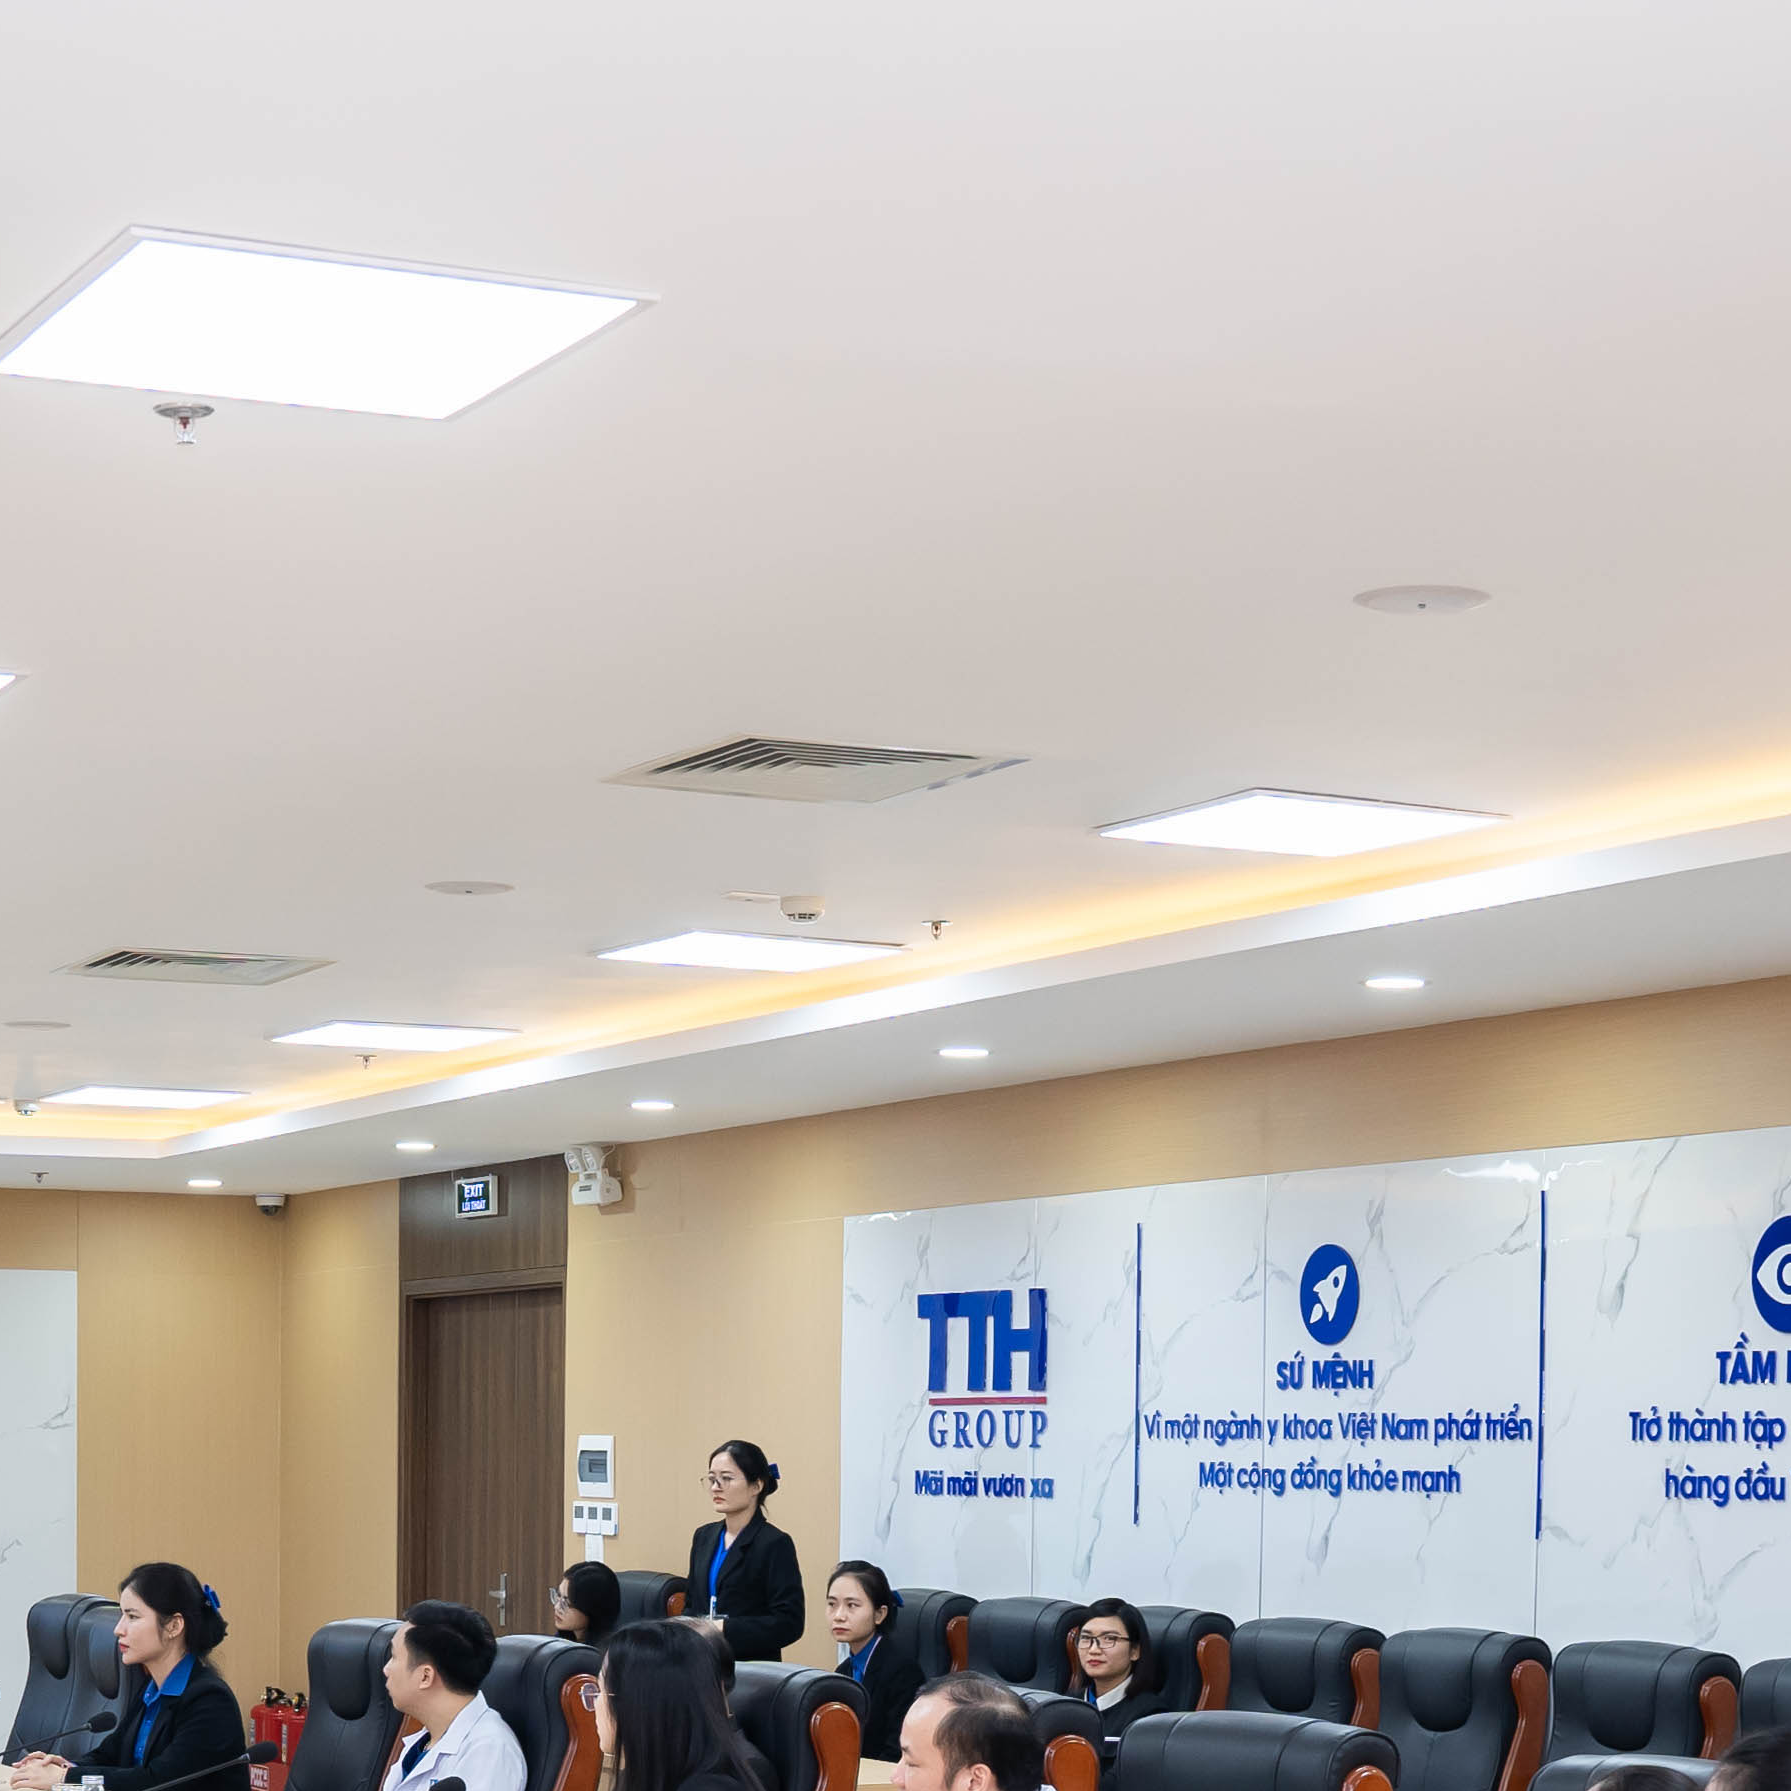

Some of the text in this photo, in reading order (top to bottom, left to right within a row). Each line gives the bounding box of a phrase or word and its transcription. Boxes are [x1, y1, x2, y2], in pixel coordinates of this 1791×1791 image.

[464, 1183, 484, 1198] EXIT
[917, 1288, 1048, 1392] TTH
[1716, 1333, 1777, 1384] TẦM
[1276, 1352, 1374, 1396] SỨ MỆNH
[929, 1409, 1047, 1448] GROUP
[1144, 1403, 1533, 1447] Vì một ngành y khoa Việt Nam phát triển
[1629, 1406, 1663, 1442] Trở
[1668, 1408, 1737, 1443] thành
[1743, 1411, 1787, 1450] tập
[914, 1470, 1054, 1500] Mãi mãi vươn xa
[1199, 1456, 1461, 1499] Một cộng đồng khỏe mạnh
[1665, 1465, 1731, 1508] hàng
[1734, 1461, 1786, 1501] đầu
